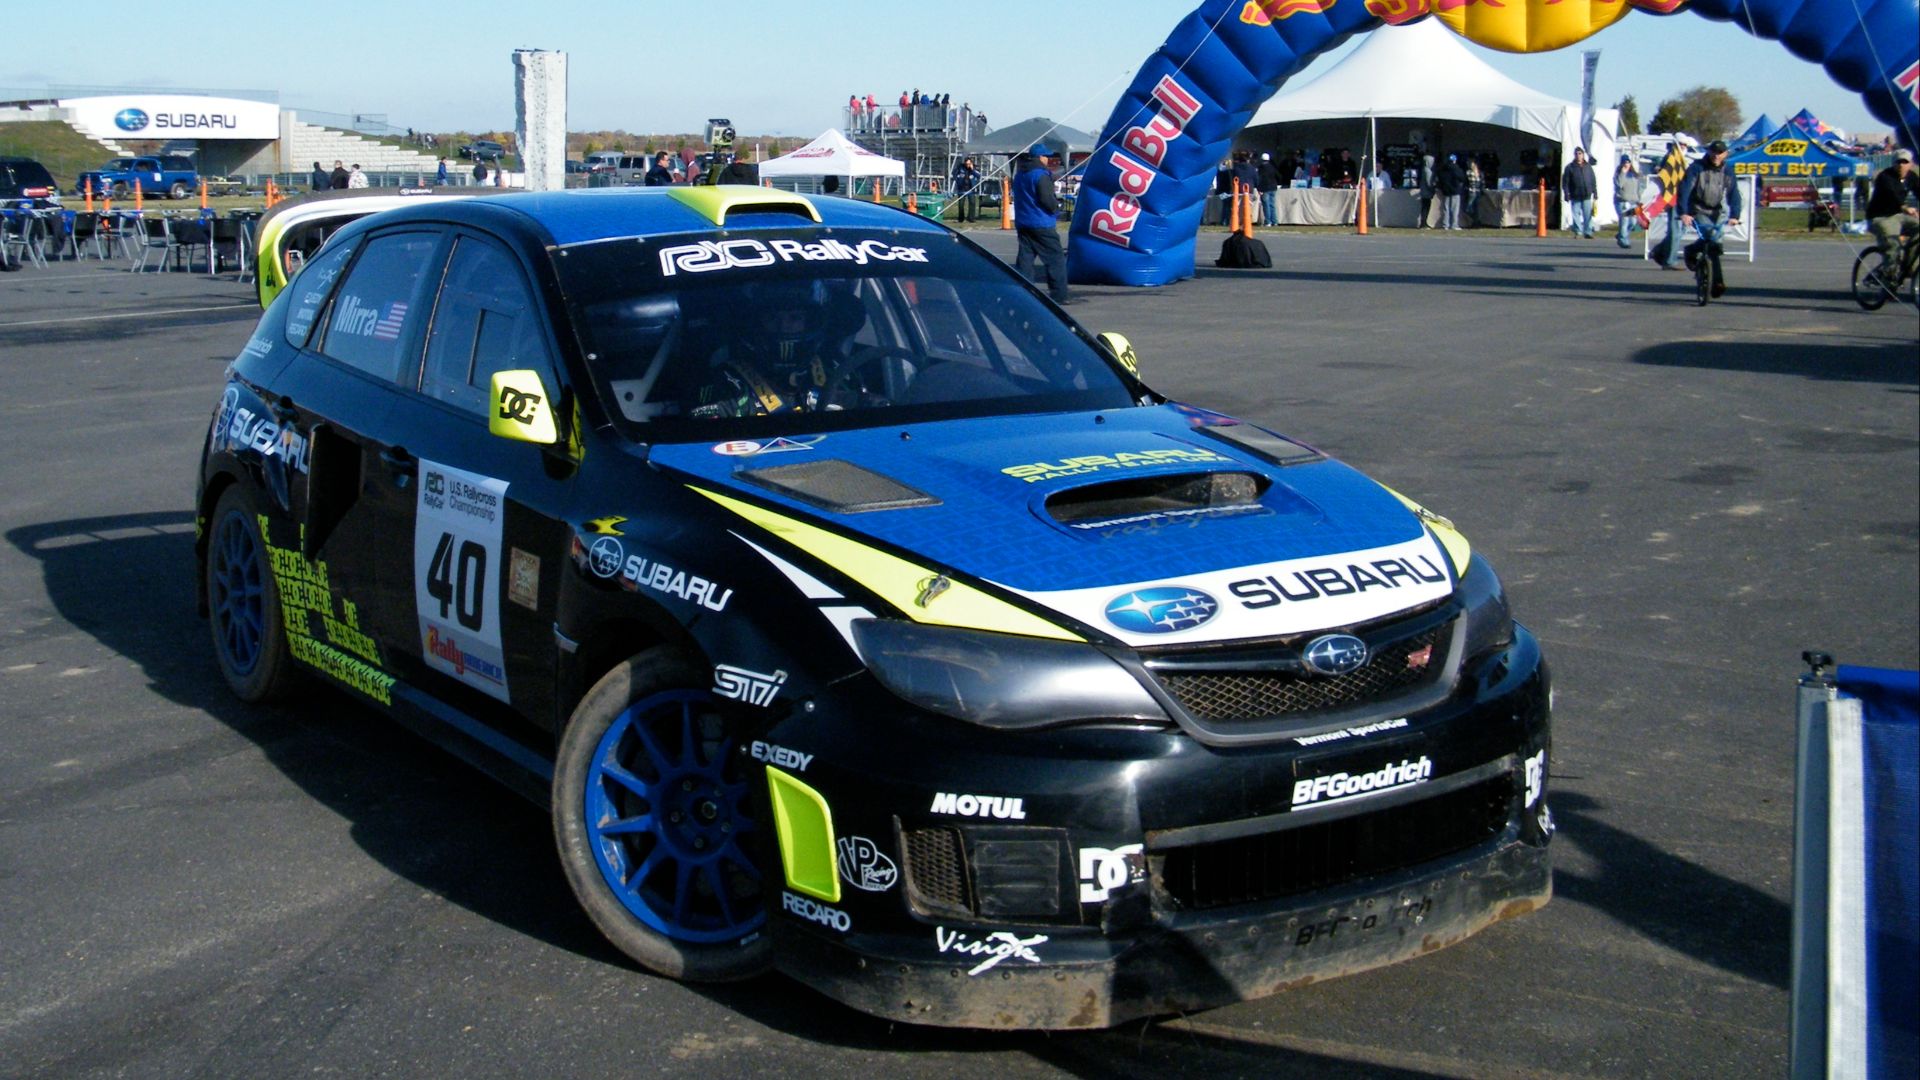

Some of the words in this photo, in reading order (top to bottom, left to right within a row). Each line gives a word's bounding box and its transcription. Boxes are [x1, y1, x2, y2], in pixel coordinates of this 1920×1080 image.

[155, 113, 237, 129] SUBARU
[1121, 73, 1203, 169] Bull
[1770, 142, 1804, 150] BEST
[1734, 162, 1782, 175] BEST
[1787, 162, 1827, 175] BUY
[1089, 151, 1156, 248] Red
[769, 239, 929, 264] RallyCar
[334, 295, 379, 337] Mirra
[499, 386, 541, 425] DC
[1001, 448, 1217, 478] SUBARU
[1022, 465, 1099, 483] RALLY
[1104, 458, 1179, 469] TEAM
[449, 480, 463, 496] U.S.
[463, 484, 497, 507] Rallycross
[449, 495, 496, 524] Championship
[427, 532, 486, 632] 40
[623, 554, 733, 612] SUBARU
[1228, 555, 1446, 609] SUBARU
[1293, 730, 1350, 746] Vermont
[751, 740, 814, 771] EXEDY
[1291, 755, 1432, 804] BFGoodrich
[930, 792, 1026, 819] MOTUL
[782, 891, 851, 932] RECARO
